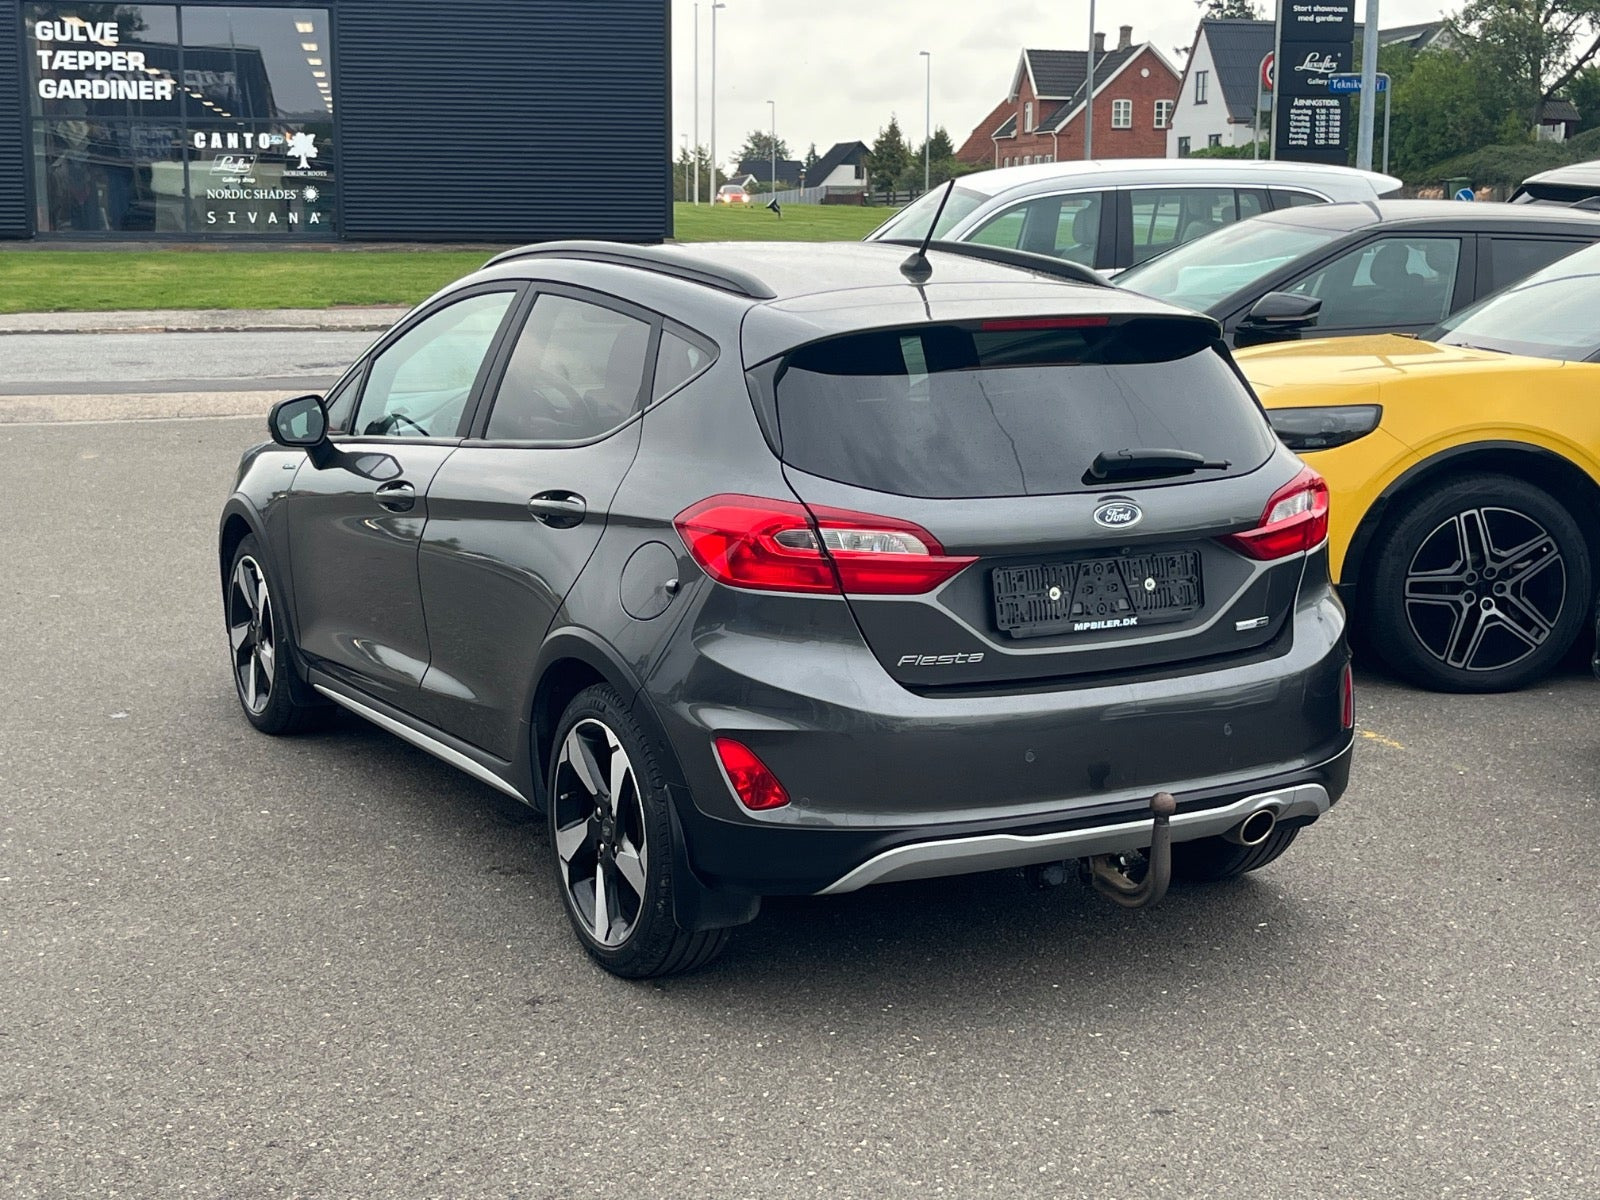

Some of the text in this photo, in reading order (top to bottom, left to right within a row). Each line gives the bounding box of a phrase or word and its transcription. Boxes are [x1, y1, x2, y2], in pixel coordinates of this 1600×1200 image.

[1313, 5, 1348, 13] showroom
[1298, 14, 1343, 23] med gardiner
[35, 21, 119, 42] GULVE
[37, 50, 145, 71] TÆPPER
[1307, 78, 1328, 86] Gallery
[38, 79, 172, 100] GARDINER
[194, 132, 271, 149] CANTO
[207, 189, 297, 199] NORDIC SHADES
[207, 211, 320, 224] SIVANA
[1104, 508, 1131, 522] Ford
[1074, 617, 1138, 631] MPBILER.DK
[897, 652, 985, 667] Fiesta
